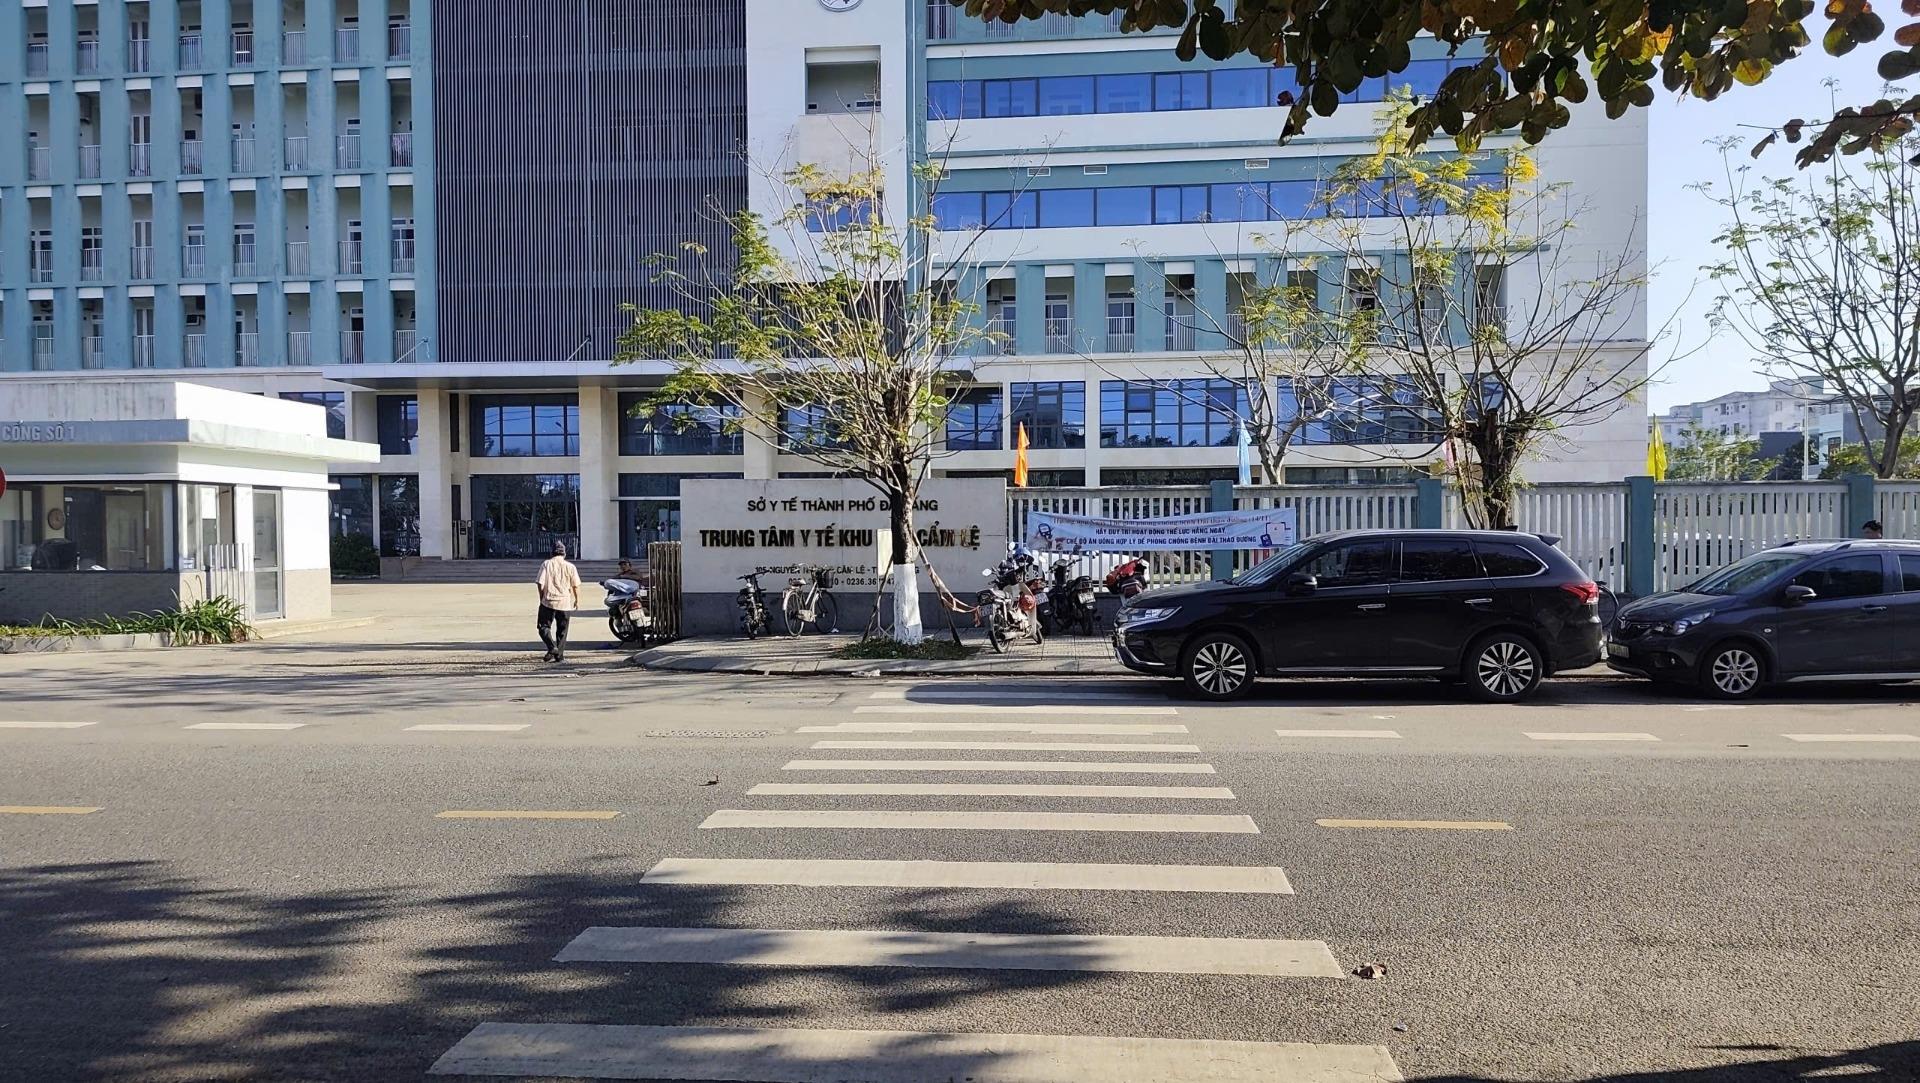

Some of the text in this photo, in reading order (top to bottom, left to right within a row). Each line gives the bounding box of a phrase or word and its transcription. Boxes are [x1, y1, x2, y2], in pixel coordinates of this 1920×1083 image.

[68, 425, 75, 440] 1
[747, 496, 766, 511] SỞ
[769, 500, 778, 511] Y
[781, 496, 798, 511] TẾ
[801, 497, 844, 511] THÀNH
[848, 496, 876, 511] PHỐ
[699, 529, 755, 547] TRUNG
[759, 525, 795, 547] TÂM
[800, 529, 811, 547] Y
[815, 522, 836, 547] TẾ
[839, 529, 873, 547] KHU
